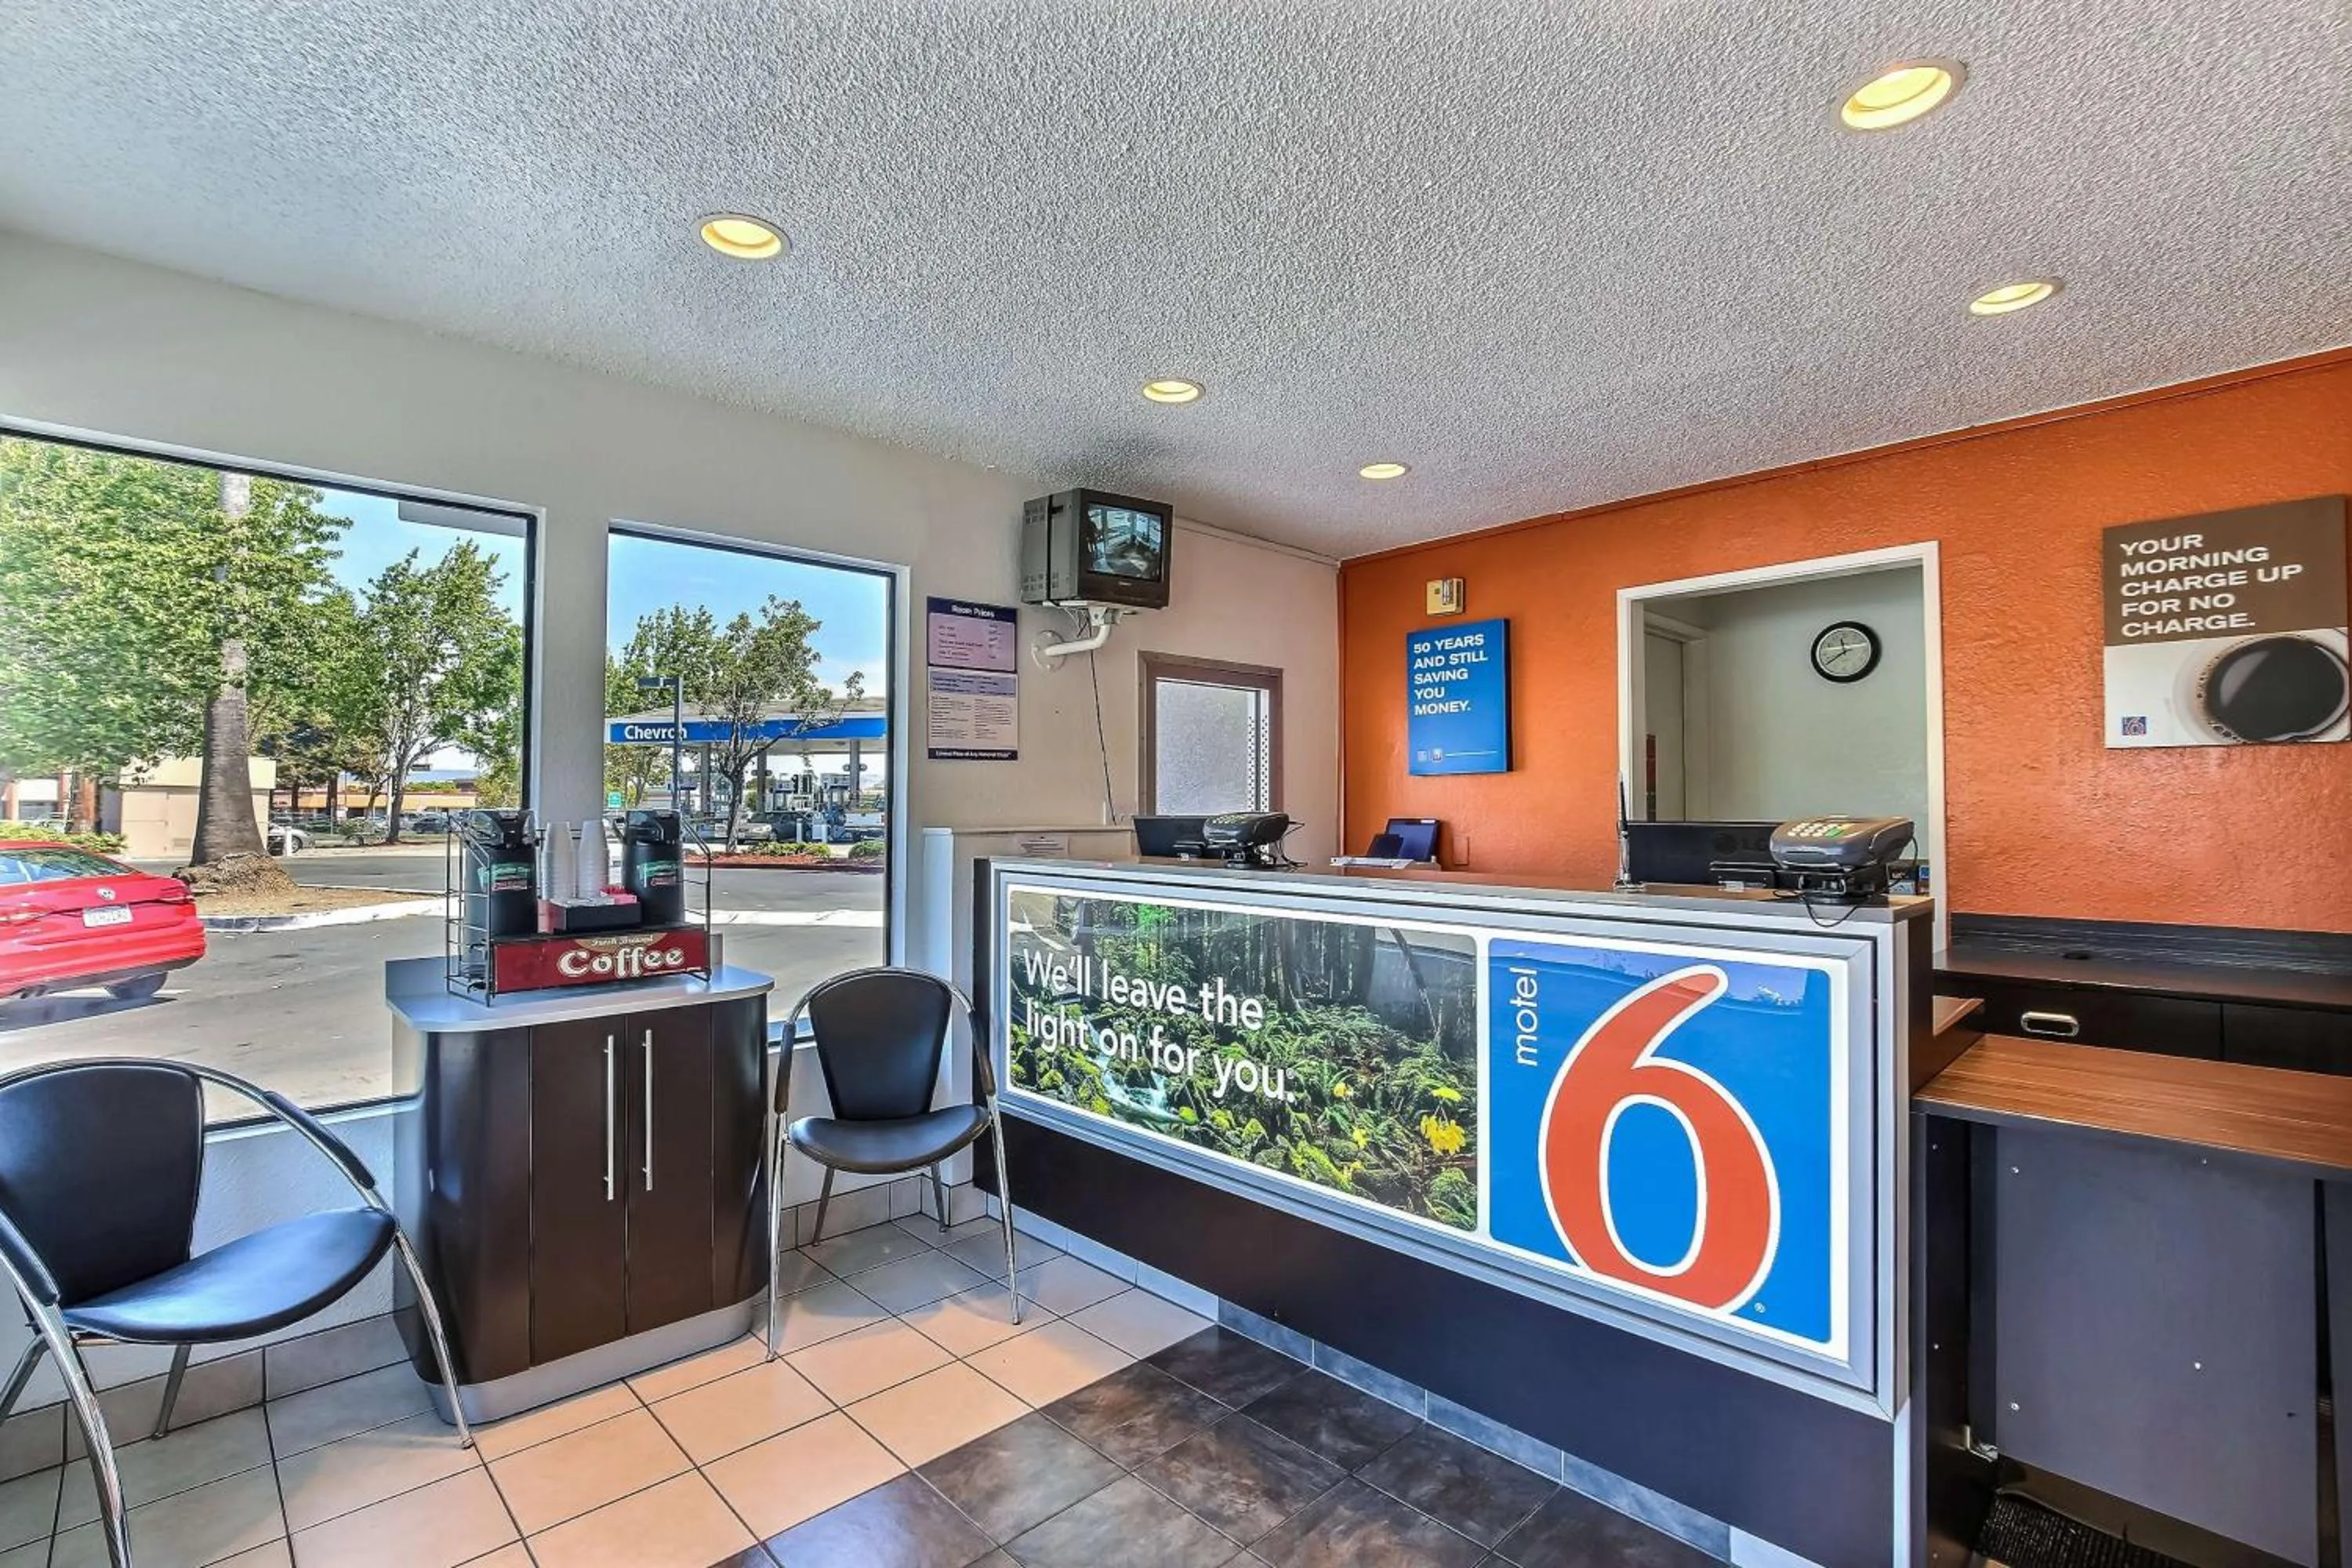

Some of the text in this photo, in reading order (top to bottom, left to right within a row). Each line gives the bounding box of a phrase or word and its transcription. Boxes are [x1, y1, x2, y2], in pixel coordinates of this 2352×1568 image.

[2119, 534, 2204, 557] YOUR
[2120, 546, 2270, 578] MORNING
[2120, 564, 2303, 597] CHARGE UP
[2121, 593, 2235, 617] FOR NO
[2121, 612, 2256, 637] CHARGE.
[1414, 633, 1484, 654] 50 YEARS
[1414, 649, 1488, 670] AND STILL
[1414, 667, 1468, 685] SAVING
[1414, 686, 1445, 700] YOU
[1414, 699, 1472, 716] MONEY.
[557, 946, 684, 979] Coffee
[1023, 949, 1264, 1030] We'll leave the
[1509, 966, 1538, 1067] motel
[1025, 996, 1089, 1052] light
[1100, 1026, 1138, 1062] on
[1149, 1025, 1200, 1075] for
[1537, 964, 1781, 1316] 6
